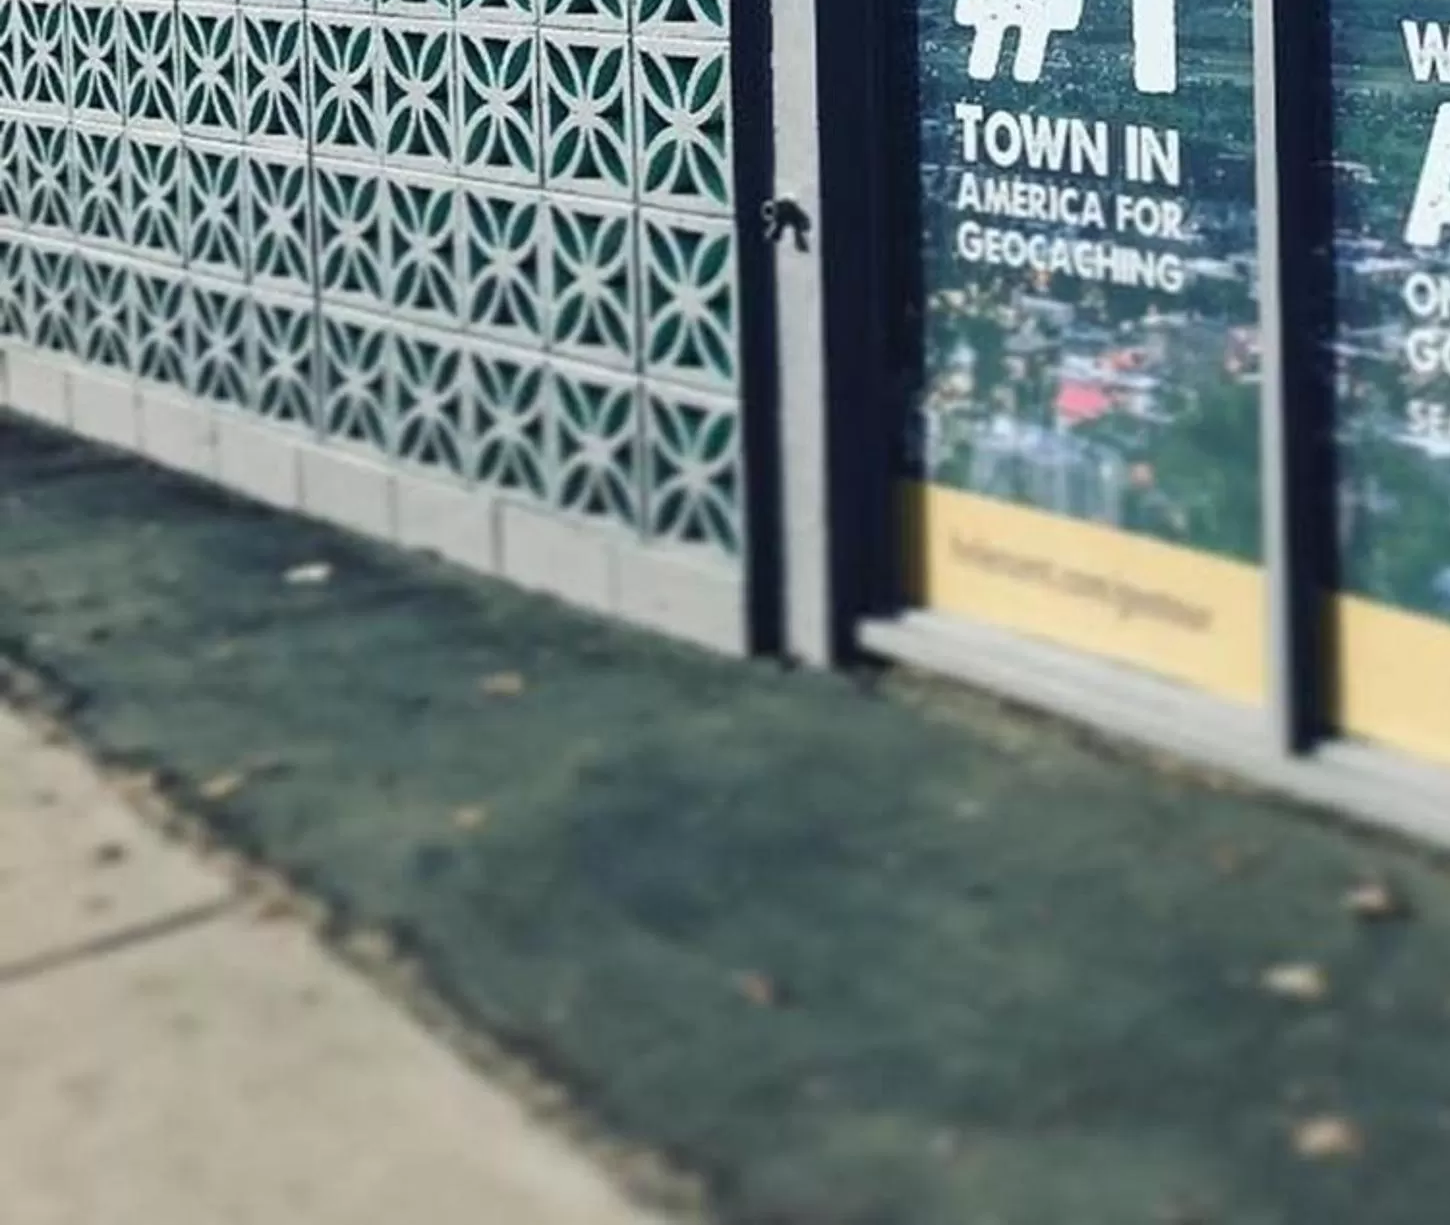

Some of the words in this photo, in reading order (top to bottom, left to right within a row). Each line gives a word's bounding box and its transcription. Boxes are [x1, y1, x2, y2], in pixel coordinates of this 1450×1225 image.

[954, 102, 1108, 177] TOWN
[1125, 124, 1180, 186] IN
[957, 172, 1106, 230] AMERICA
[1115, 193, 1184, 241] FOR
[956, 221, 1186, 294] GEOCACHING
